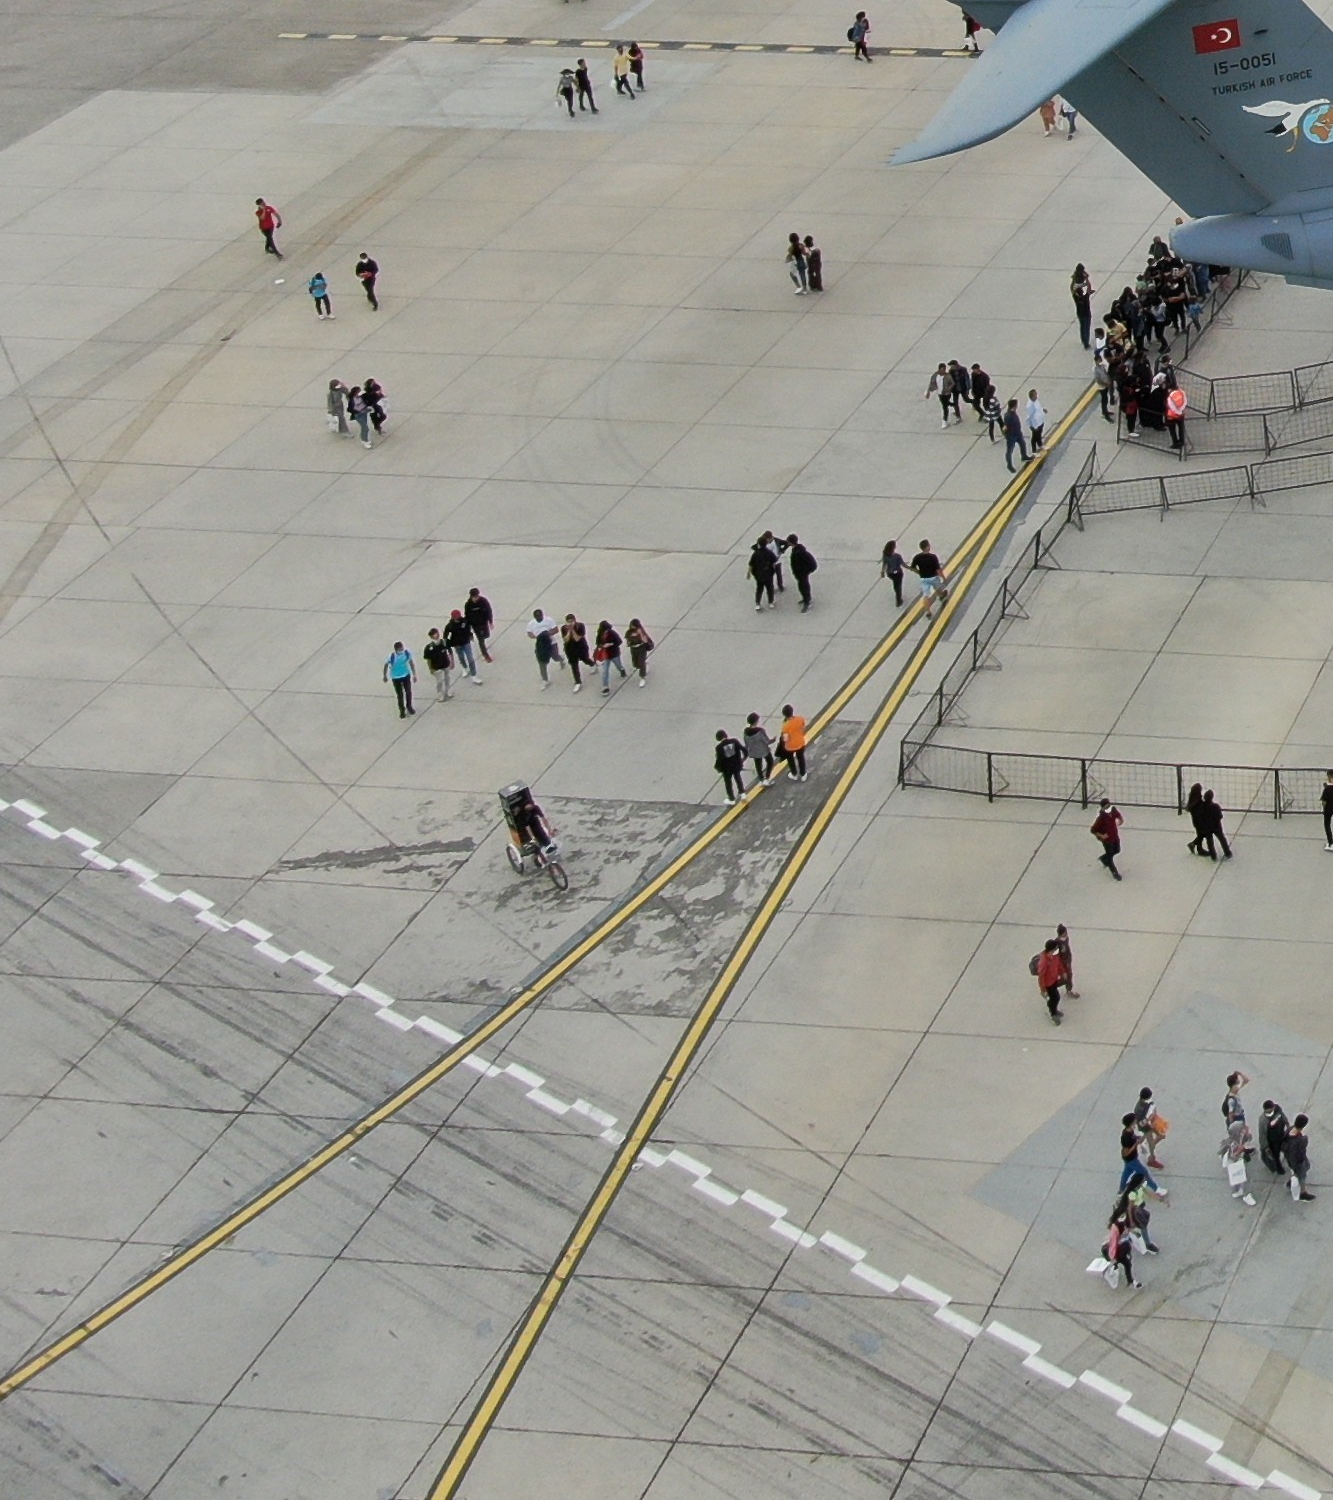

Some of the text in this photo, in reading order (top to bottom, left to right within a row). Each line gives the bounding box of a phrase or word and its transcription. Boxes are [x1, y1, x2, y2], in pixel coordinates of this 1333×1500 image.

[1214, 52, 1276, 75] 15-0051
[1211, 68, 1313, 96] TURKISH AIR FORCE
